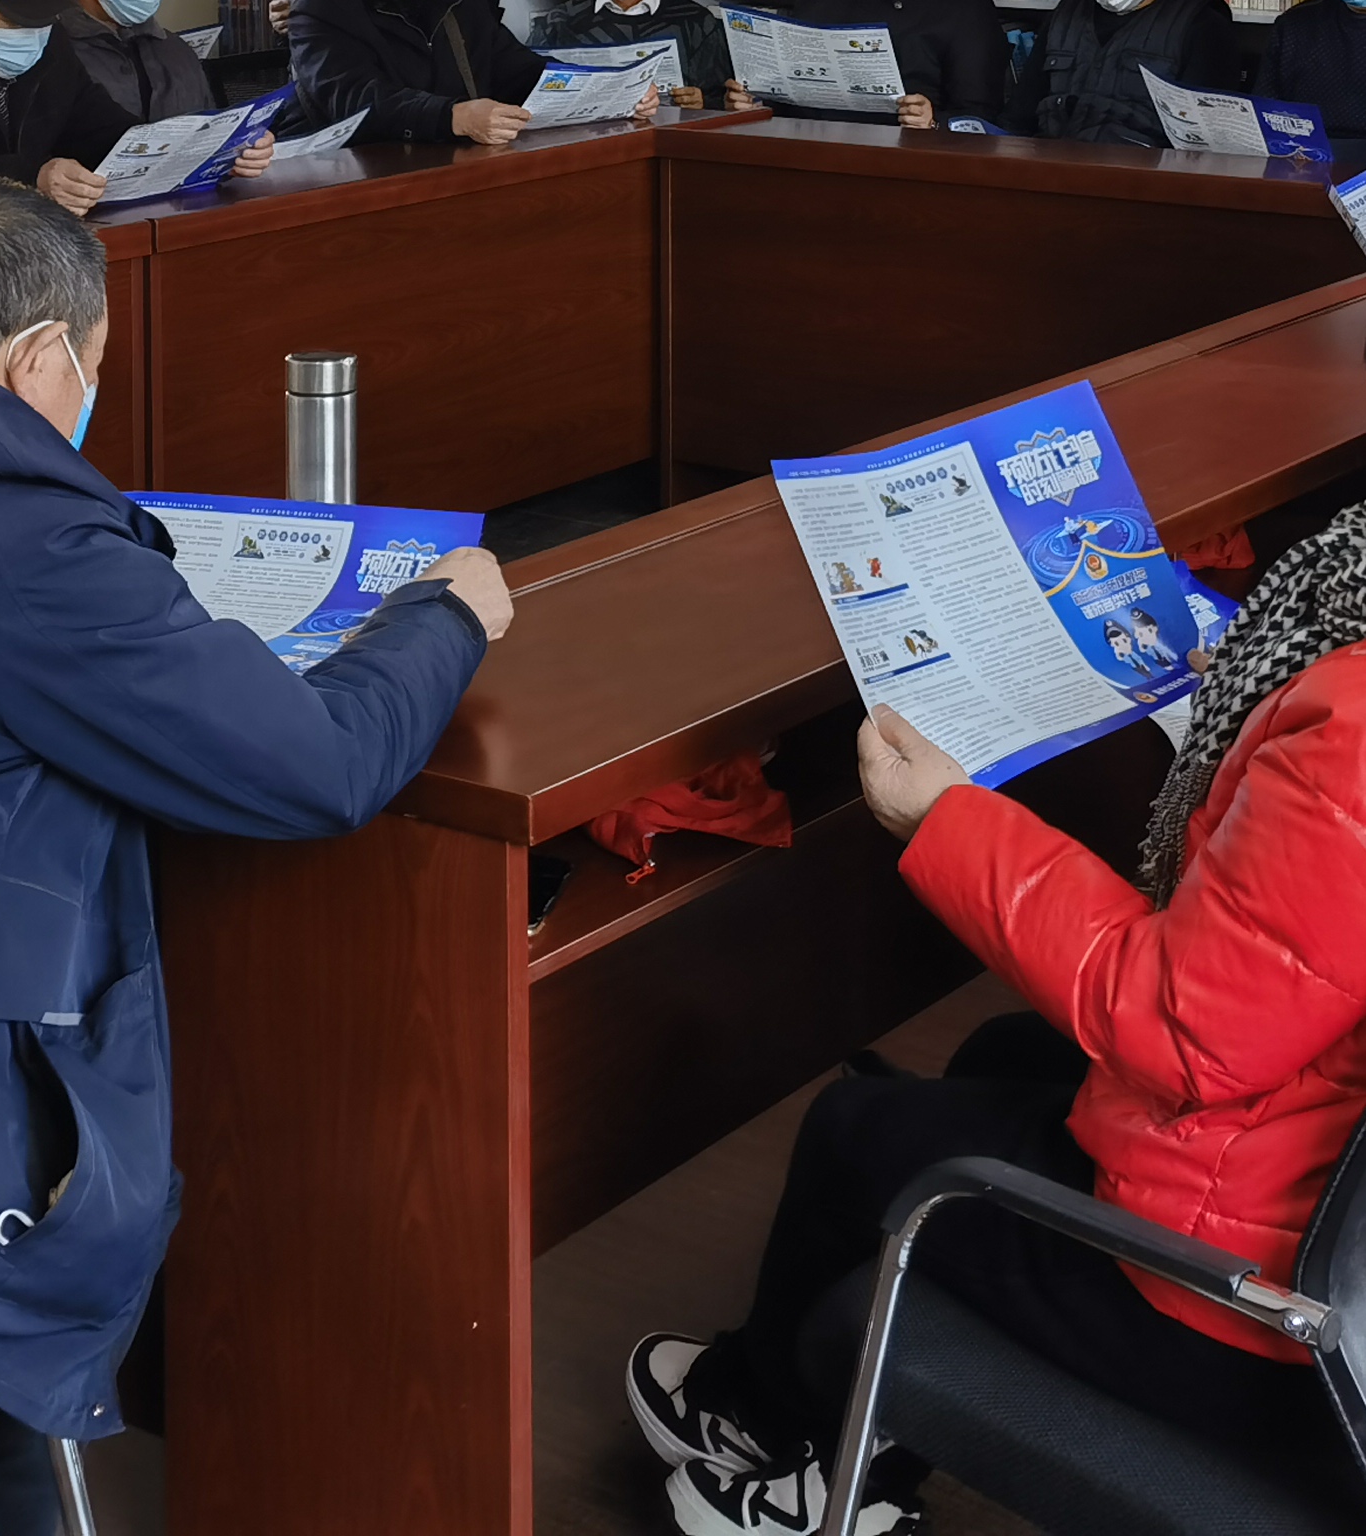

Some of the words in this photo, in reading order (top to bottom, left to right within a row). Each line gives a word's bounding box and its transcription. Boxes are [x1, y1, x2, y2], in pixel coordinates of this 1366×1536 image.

[995, 429, 1103, 489] 预防诈骗
[357, 548, 442, 578] 预防诈
